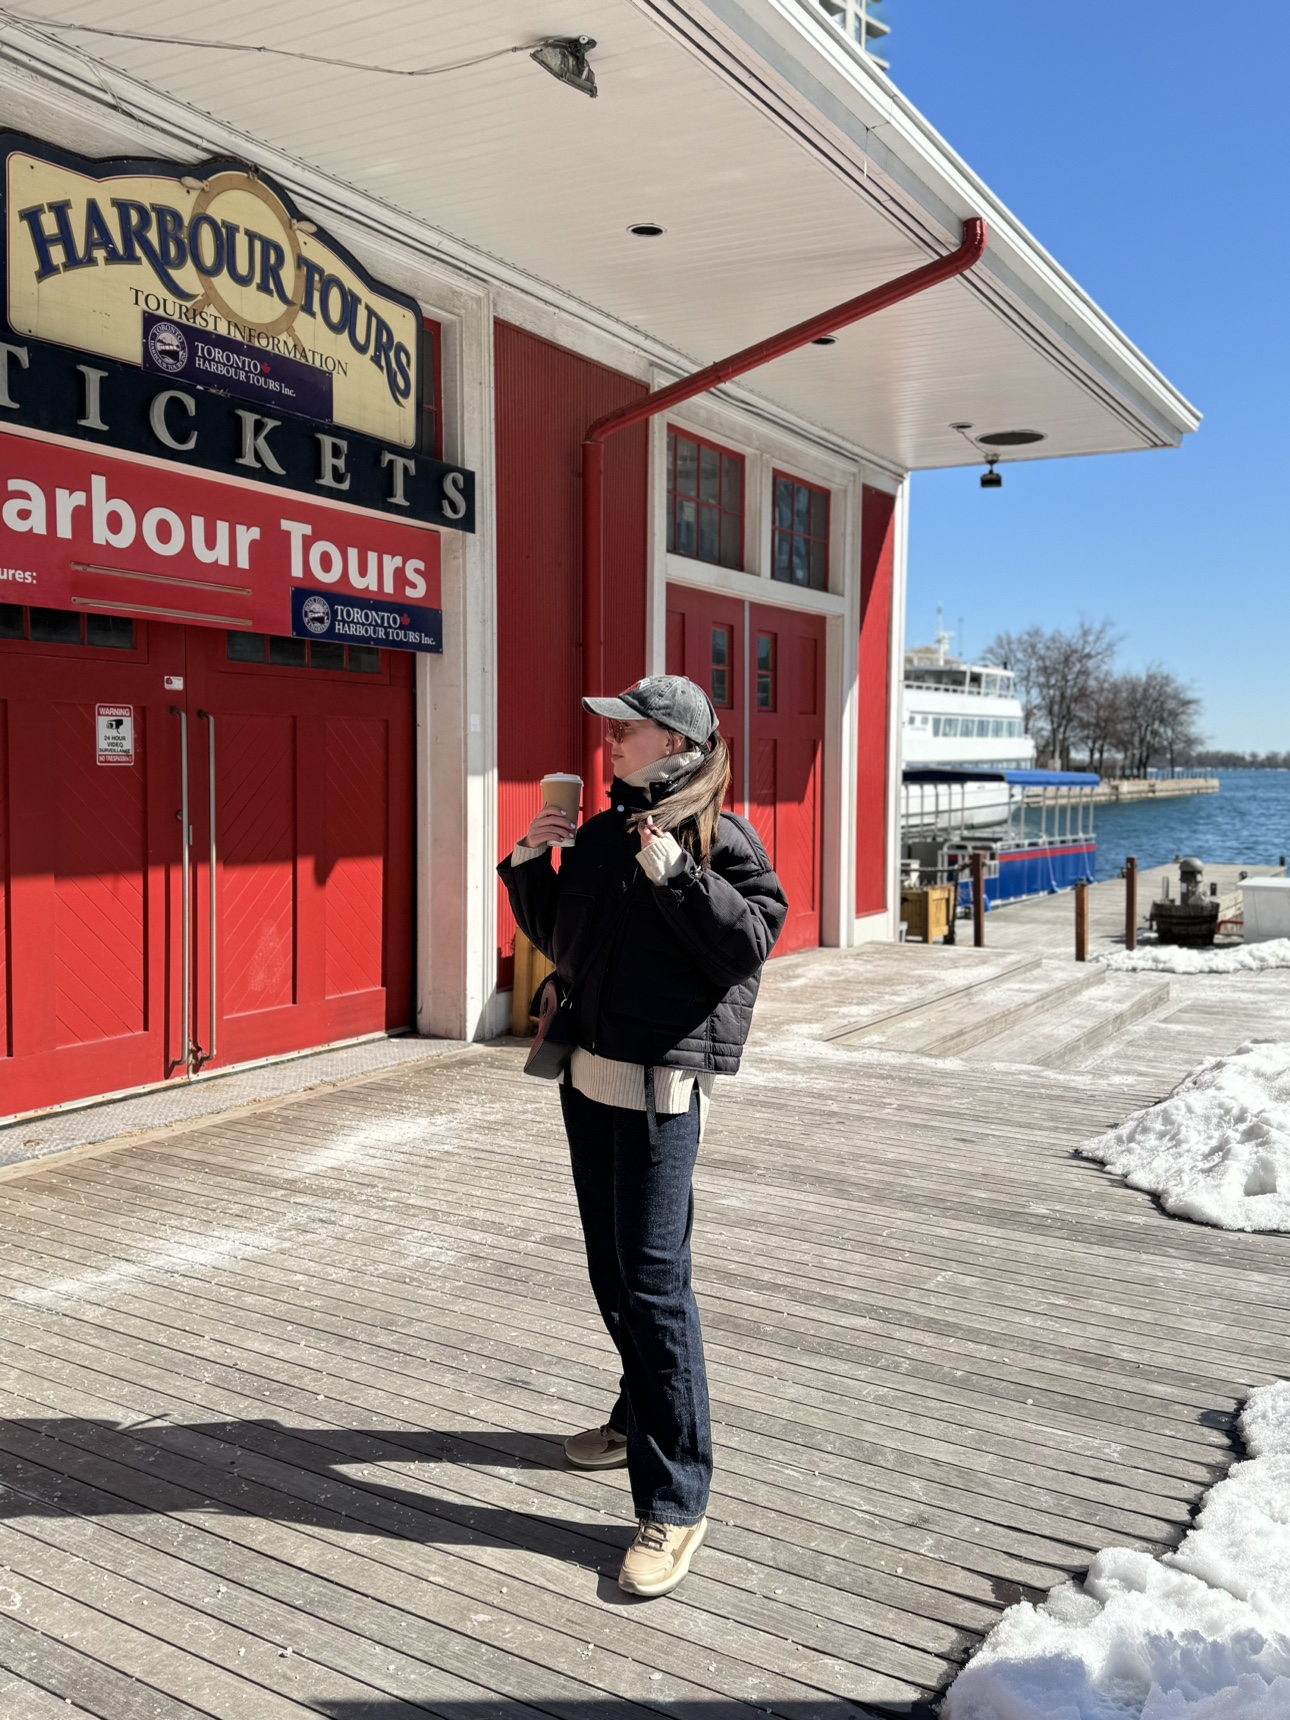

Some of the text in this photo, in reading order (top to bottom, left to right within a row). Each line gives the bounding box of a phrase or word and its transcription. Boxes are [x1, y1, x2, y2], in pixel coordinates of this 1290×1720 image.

[18, 197, 412, 409] HARBOUR TOURS
[129, 287, 348, 377] TOURIST INFORMATION
[194, 341, 261, 374] TORONTO
[195, 357, 296, 397] HARBOUR TOURS Inc.
[2, 473, 428, 598] arbour Tours
[0, 567, 37, 584] ures:
[334, 605, 400, 628] TORONTO
[334, 621, 436, 645] HARBOUR TOURS Inc.
[99, 707, 130, 716] WARNING
